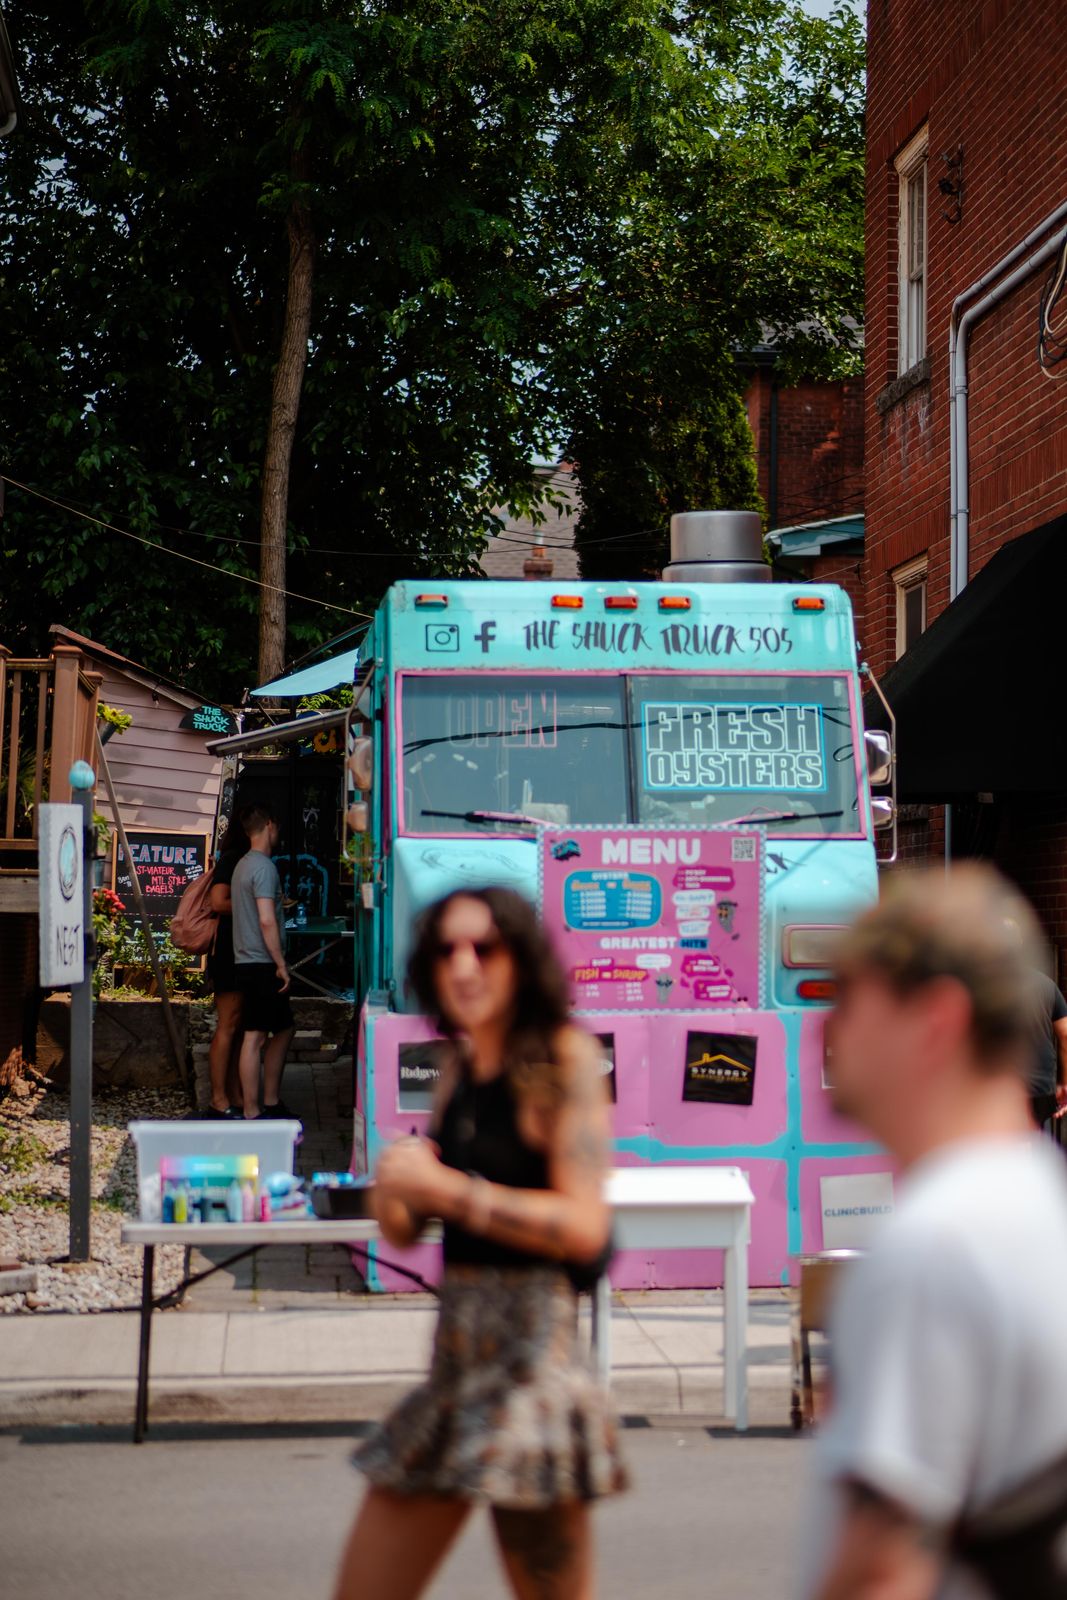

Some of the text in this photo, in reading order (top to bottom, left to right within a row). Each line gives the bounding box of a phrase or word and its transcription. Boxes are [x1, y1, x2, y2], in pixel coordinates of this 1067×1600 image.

[522, 620, 560, 650] THE
[571, 621, 652, 654] SHUCK
[660, 624, 745, 656] TRUCK
[201, 705, 221, 716] THE
[193, 713, 230, 726] SHUCK
[448, 689, 557, 748] OPEN
[192, 721, 228, 733] TRUCK
[645, 703, 820, 753] FRESH
[648, 751, 823, 788] OYSTERS
[601, 838, 701, 864] MENU
[145, 885, 174, 894] BAGELS
[600, 937, 677, 949] GREATEST
[691, 1067, 748, 1076] SYNERGY
